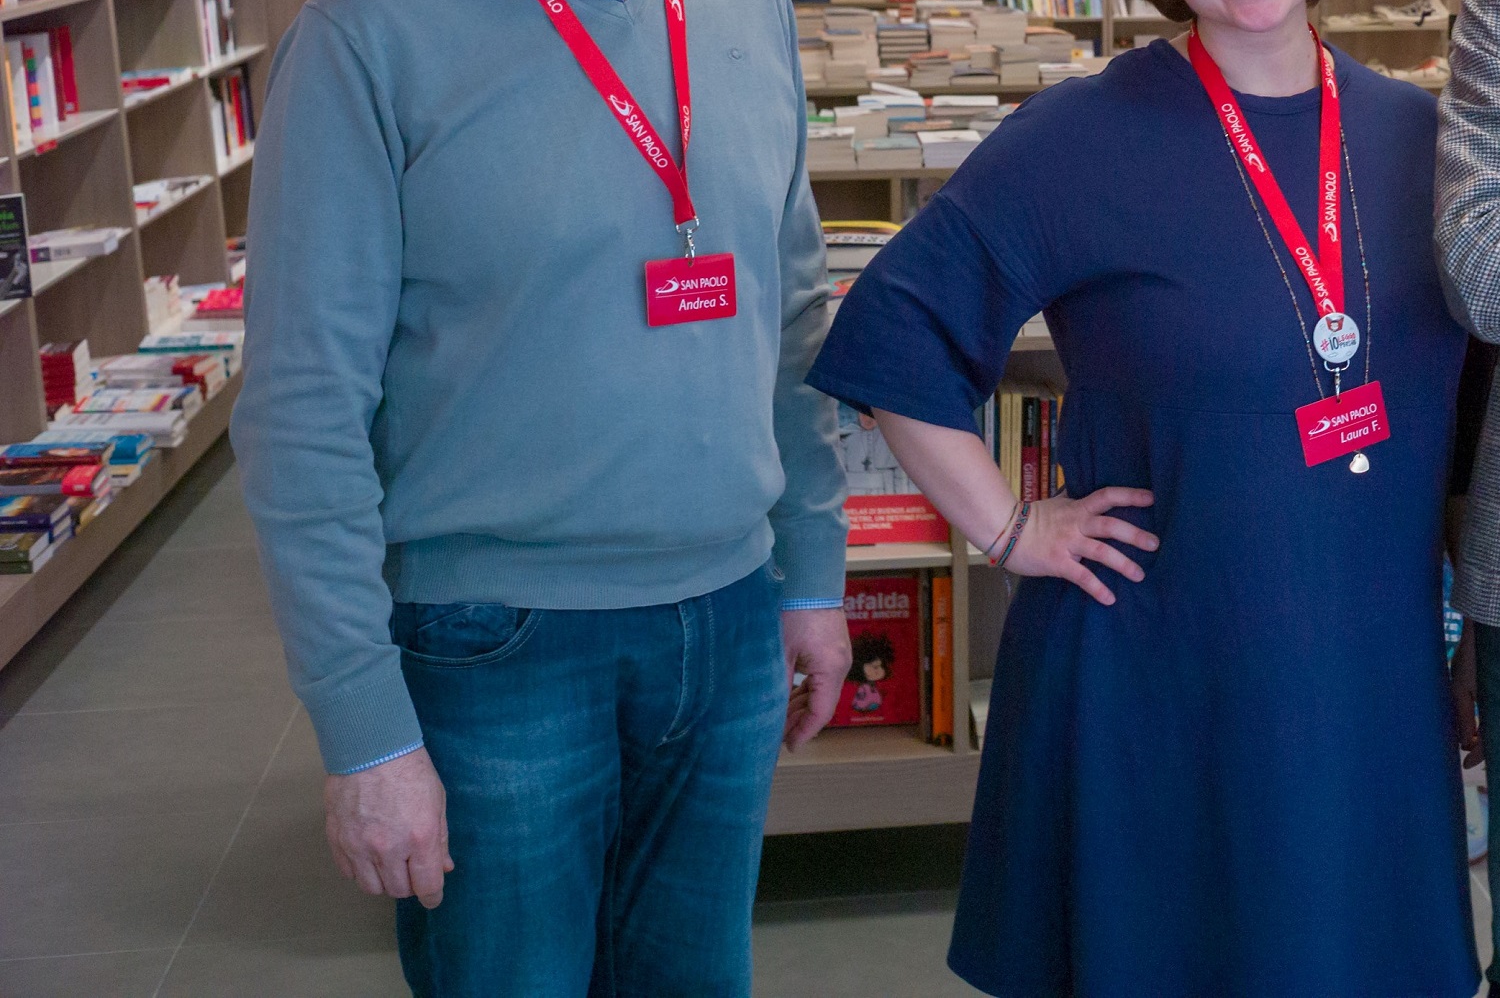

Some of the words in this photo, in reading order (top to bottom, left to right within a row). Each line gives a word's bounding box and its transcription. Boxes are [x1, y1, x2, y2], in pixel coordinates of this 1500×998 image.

[1221, 103, 1243, 134] PAOLO
[626, 114, 645, 138] SAN
[640, 135, 668, 169] PAOLO
[1238, 134, 1254, 153] SAN
[1325, 171, 1336, 202] PAOLO
[1325, 202, 1336, 221] SAN
[1296, 247, 1319, 278] PAOLO
[680, 278, 699, 290] SAN
[700, 275, 728, 288] PAOLO
[1312, 278, 1328, 298] SAN
[678, 296, 716, 311] Andrea
[719, 294, 729, 306] S.
[1331, 414, 1349, 427] SAN
[1350, 403, 1377, 420] PAOLO
[1340, 425, 1369, 443] Laura
[1371, 419, 1381, 432] F.
[1023, 463, 1033, 502] GIBRAN
[844, 592, 910, 610] afalda
